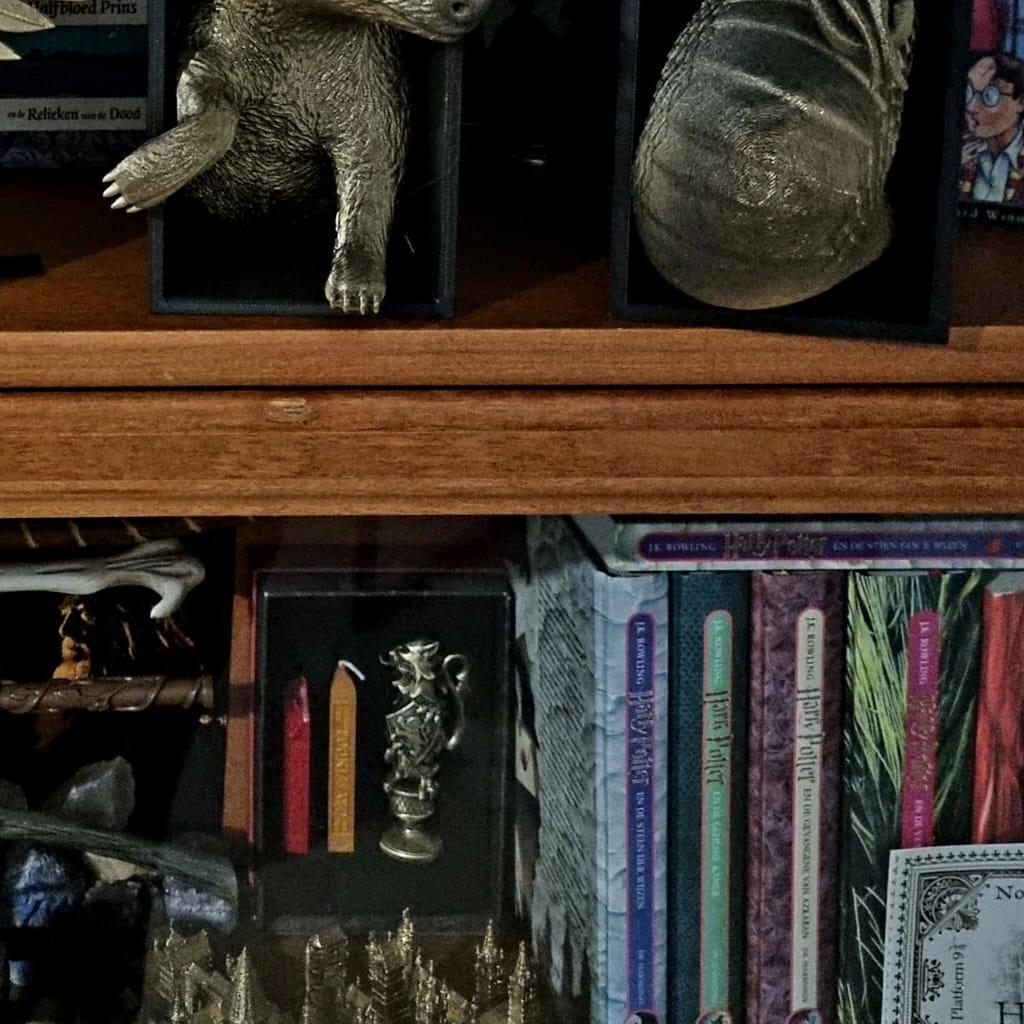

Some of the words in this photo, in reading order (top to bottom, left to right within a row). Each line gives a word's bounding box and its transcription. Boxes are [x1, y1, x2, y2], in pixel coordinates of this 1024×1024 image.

[99, 0, 138, 16] Prins
[27, 107, 79, 121] Relieken
[109, 106, 141, 120] Dood
[666, 542, 717, 552] ROWLING
[636, 638, 647, 685] ROWLING
[805, 634, 816, 681] ROWLING
[918, 637, 930, 685] ROWLING
[628, 691, 654, 735] Harry
[628, 737, 654, 785] Potter
[796, 733, 825, 784] Potter
[635, 792, 646, 805] EN
[802, 788, 813, 801] EN
[635, 807, 646, 821] DE
[802, 803, 813, 816] DE
[635, 822, 646, 853] STEEN
[801, 875, 812, 896] VAN
[950, 962, 964, 1020] Platform
